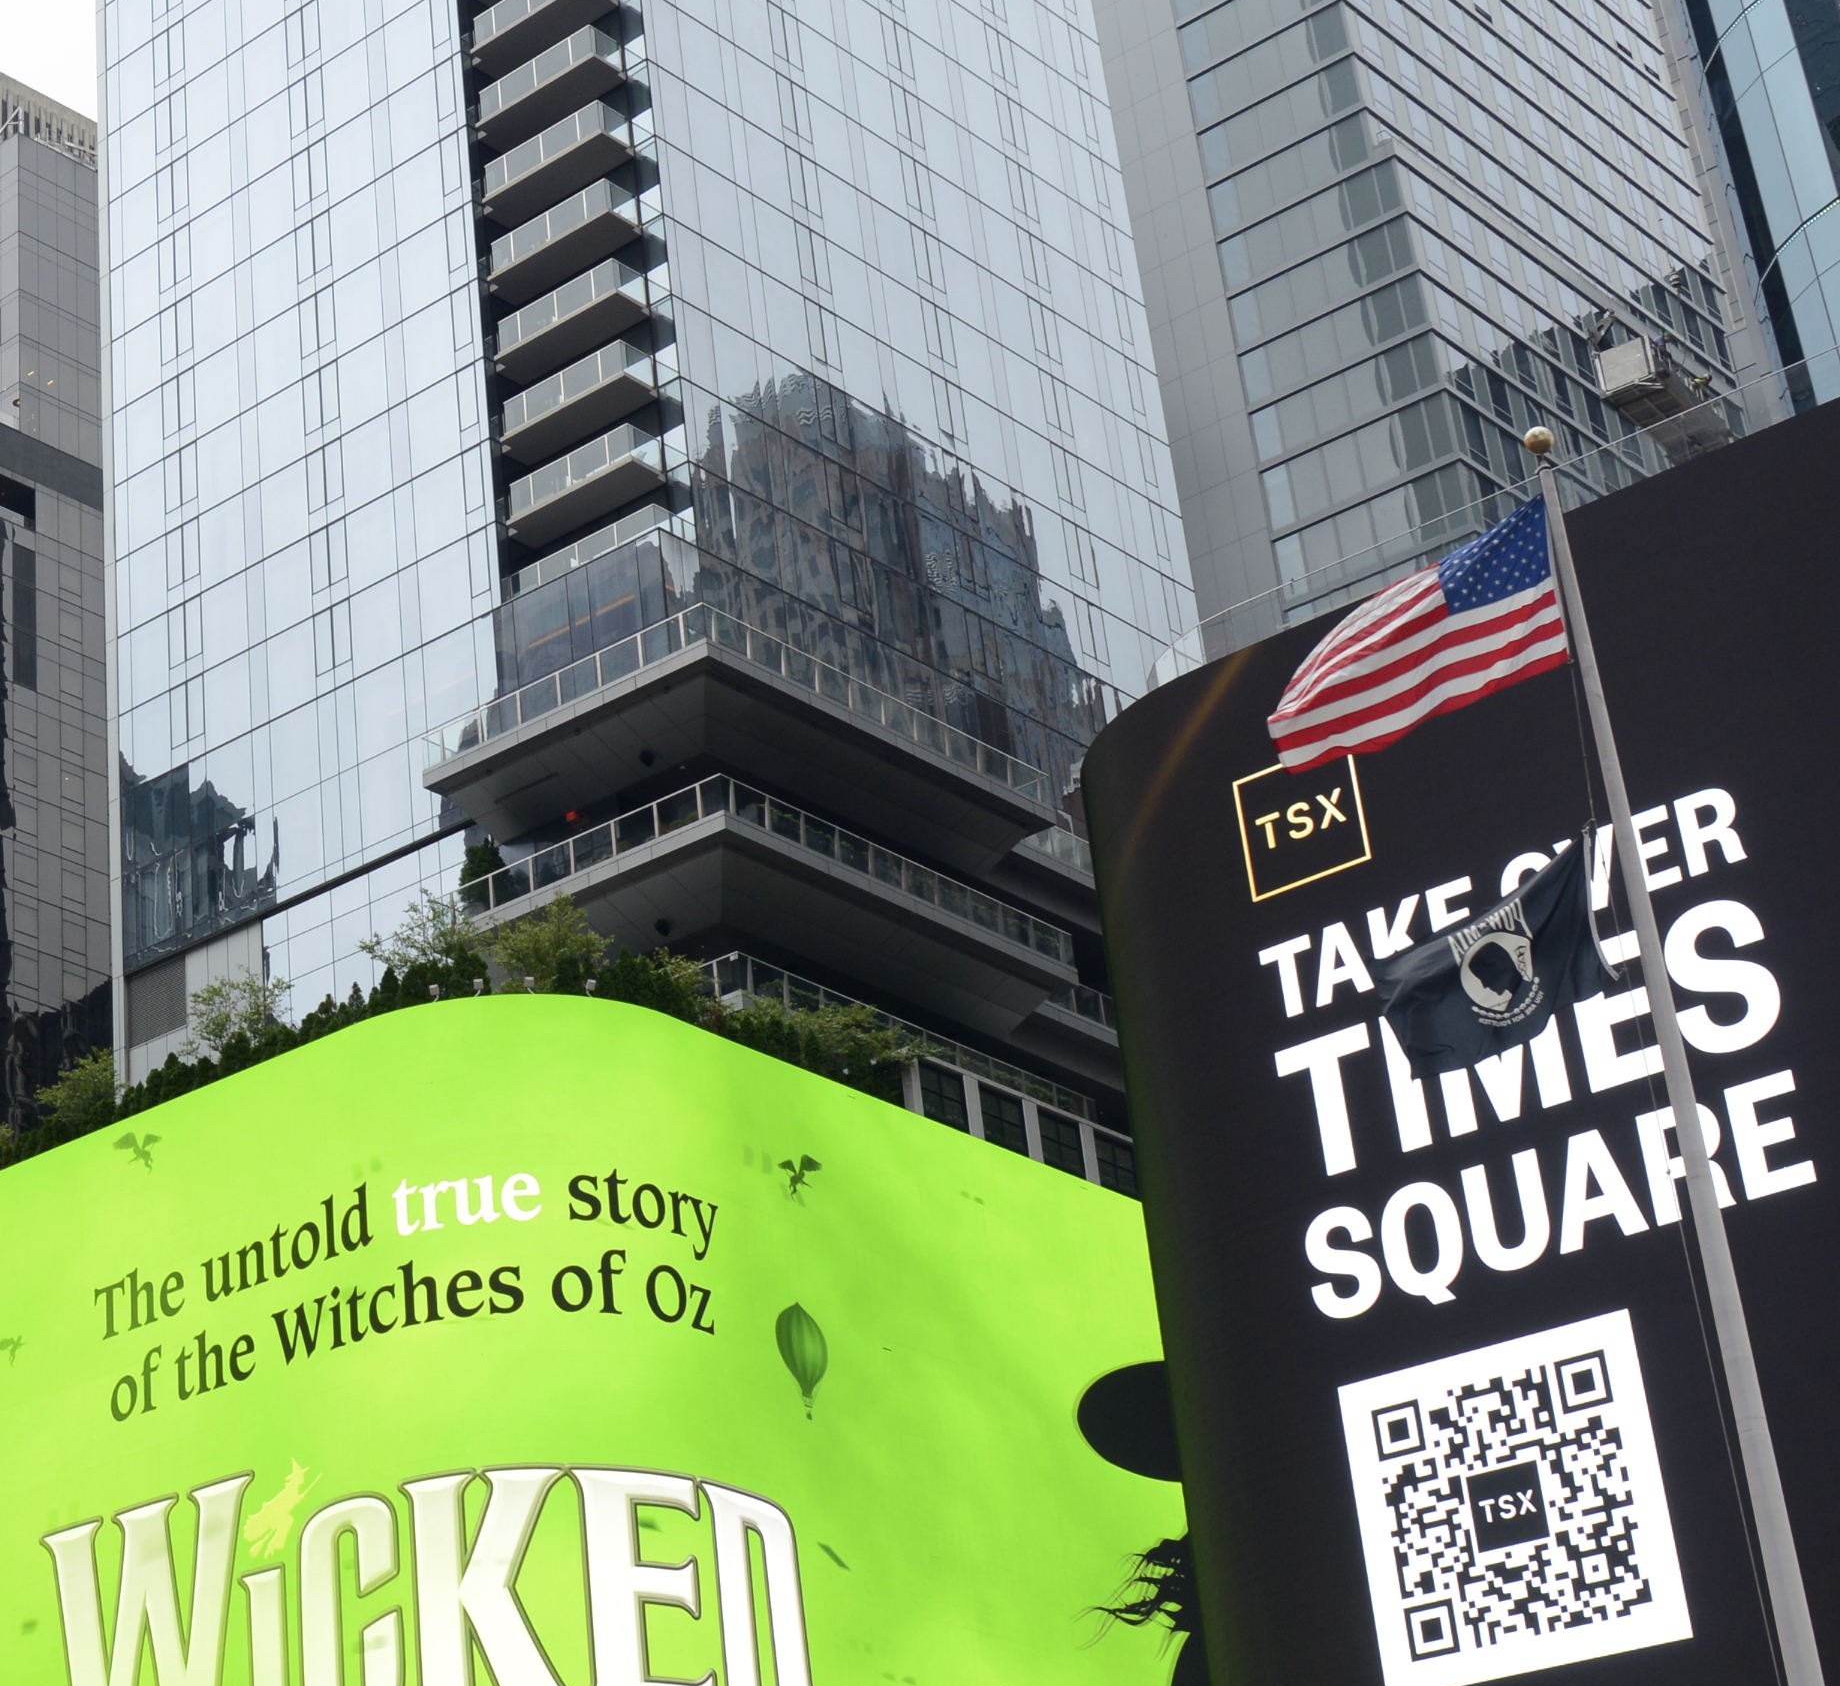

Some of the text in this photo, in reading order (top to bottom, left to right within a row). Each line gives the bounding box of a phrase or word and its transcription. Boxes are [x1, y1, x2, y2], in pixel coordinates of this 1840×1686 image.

[1254, 787, 1347, 851] TSX
[1257, 875, 1477, 1019] TAKE
[1274, 898, 1784, 1178] TIMES
[93, 1167, 720, 1341] The untold true story
[1303, 1069, 1819, 1321] SQUARE
[109, 1249, 718, 1423] of the Witches of Oz
[1477, 1488, 1538, 1525] TSX
